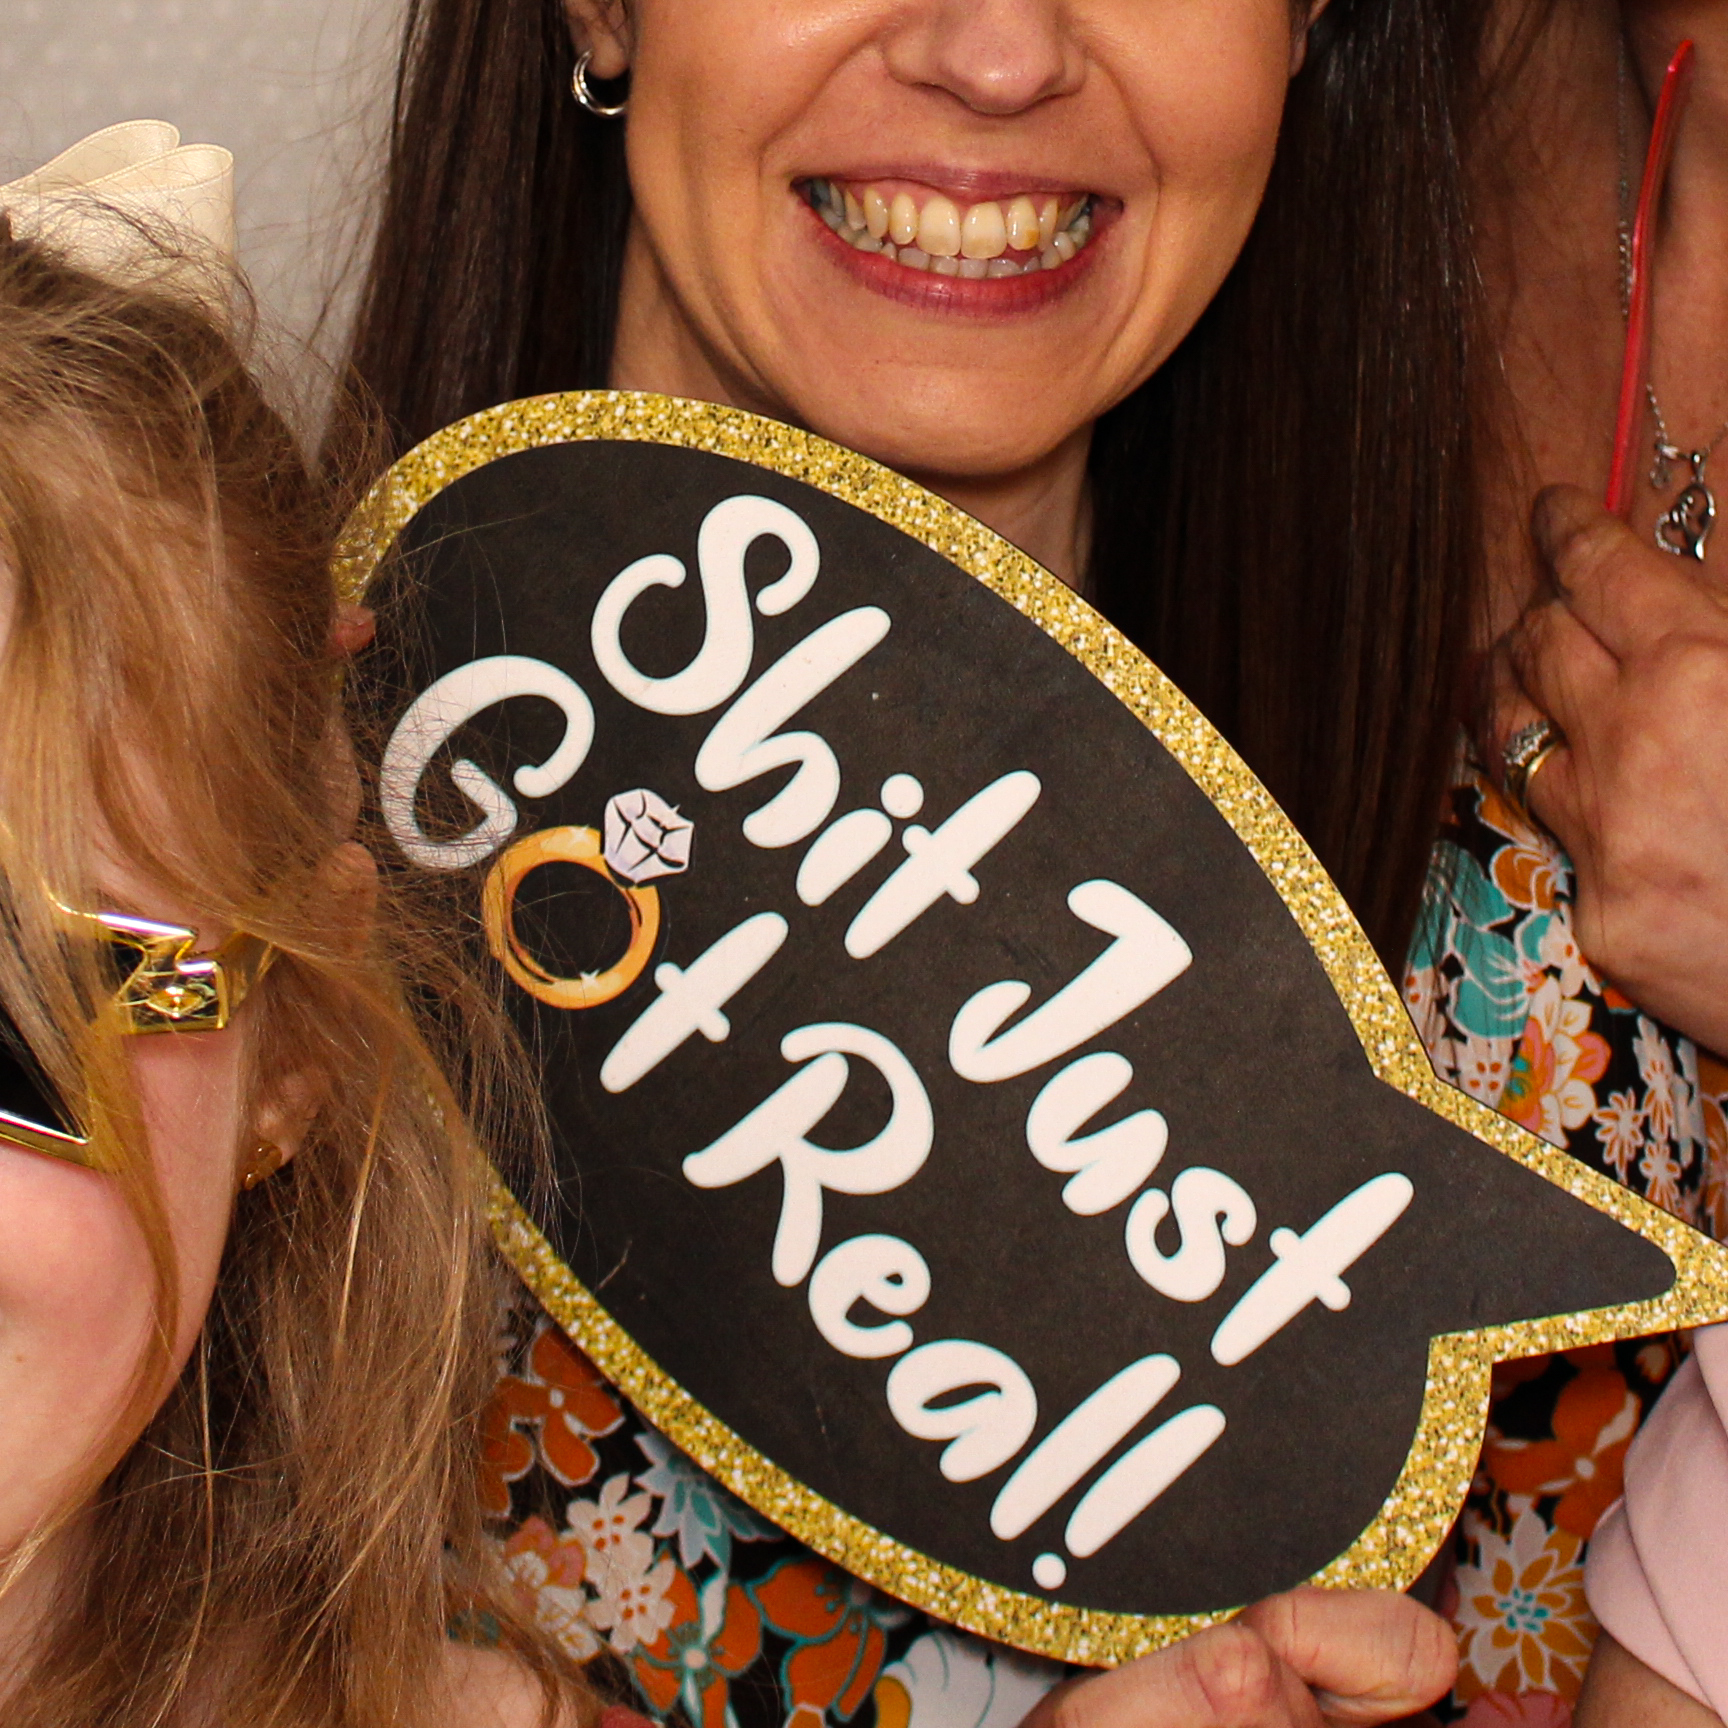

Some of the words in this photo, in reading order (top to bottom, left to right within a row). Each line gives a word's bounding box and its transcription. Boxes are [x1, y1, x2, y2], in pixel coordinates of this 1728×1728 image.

[379, 654, 790, 1094] Got
[681, 1022, 1227, 1589] Real!
[590, 494, 1042, 959] Shit
[947, 879, 1415, 1366] Just
